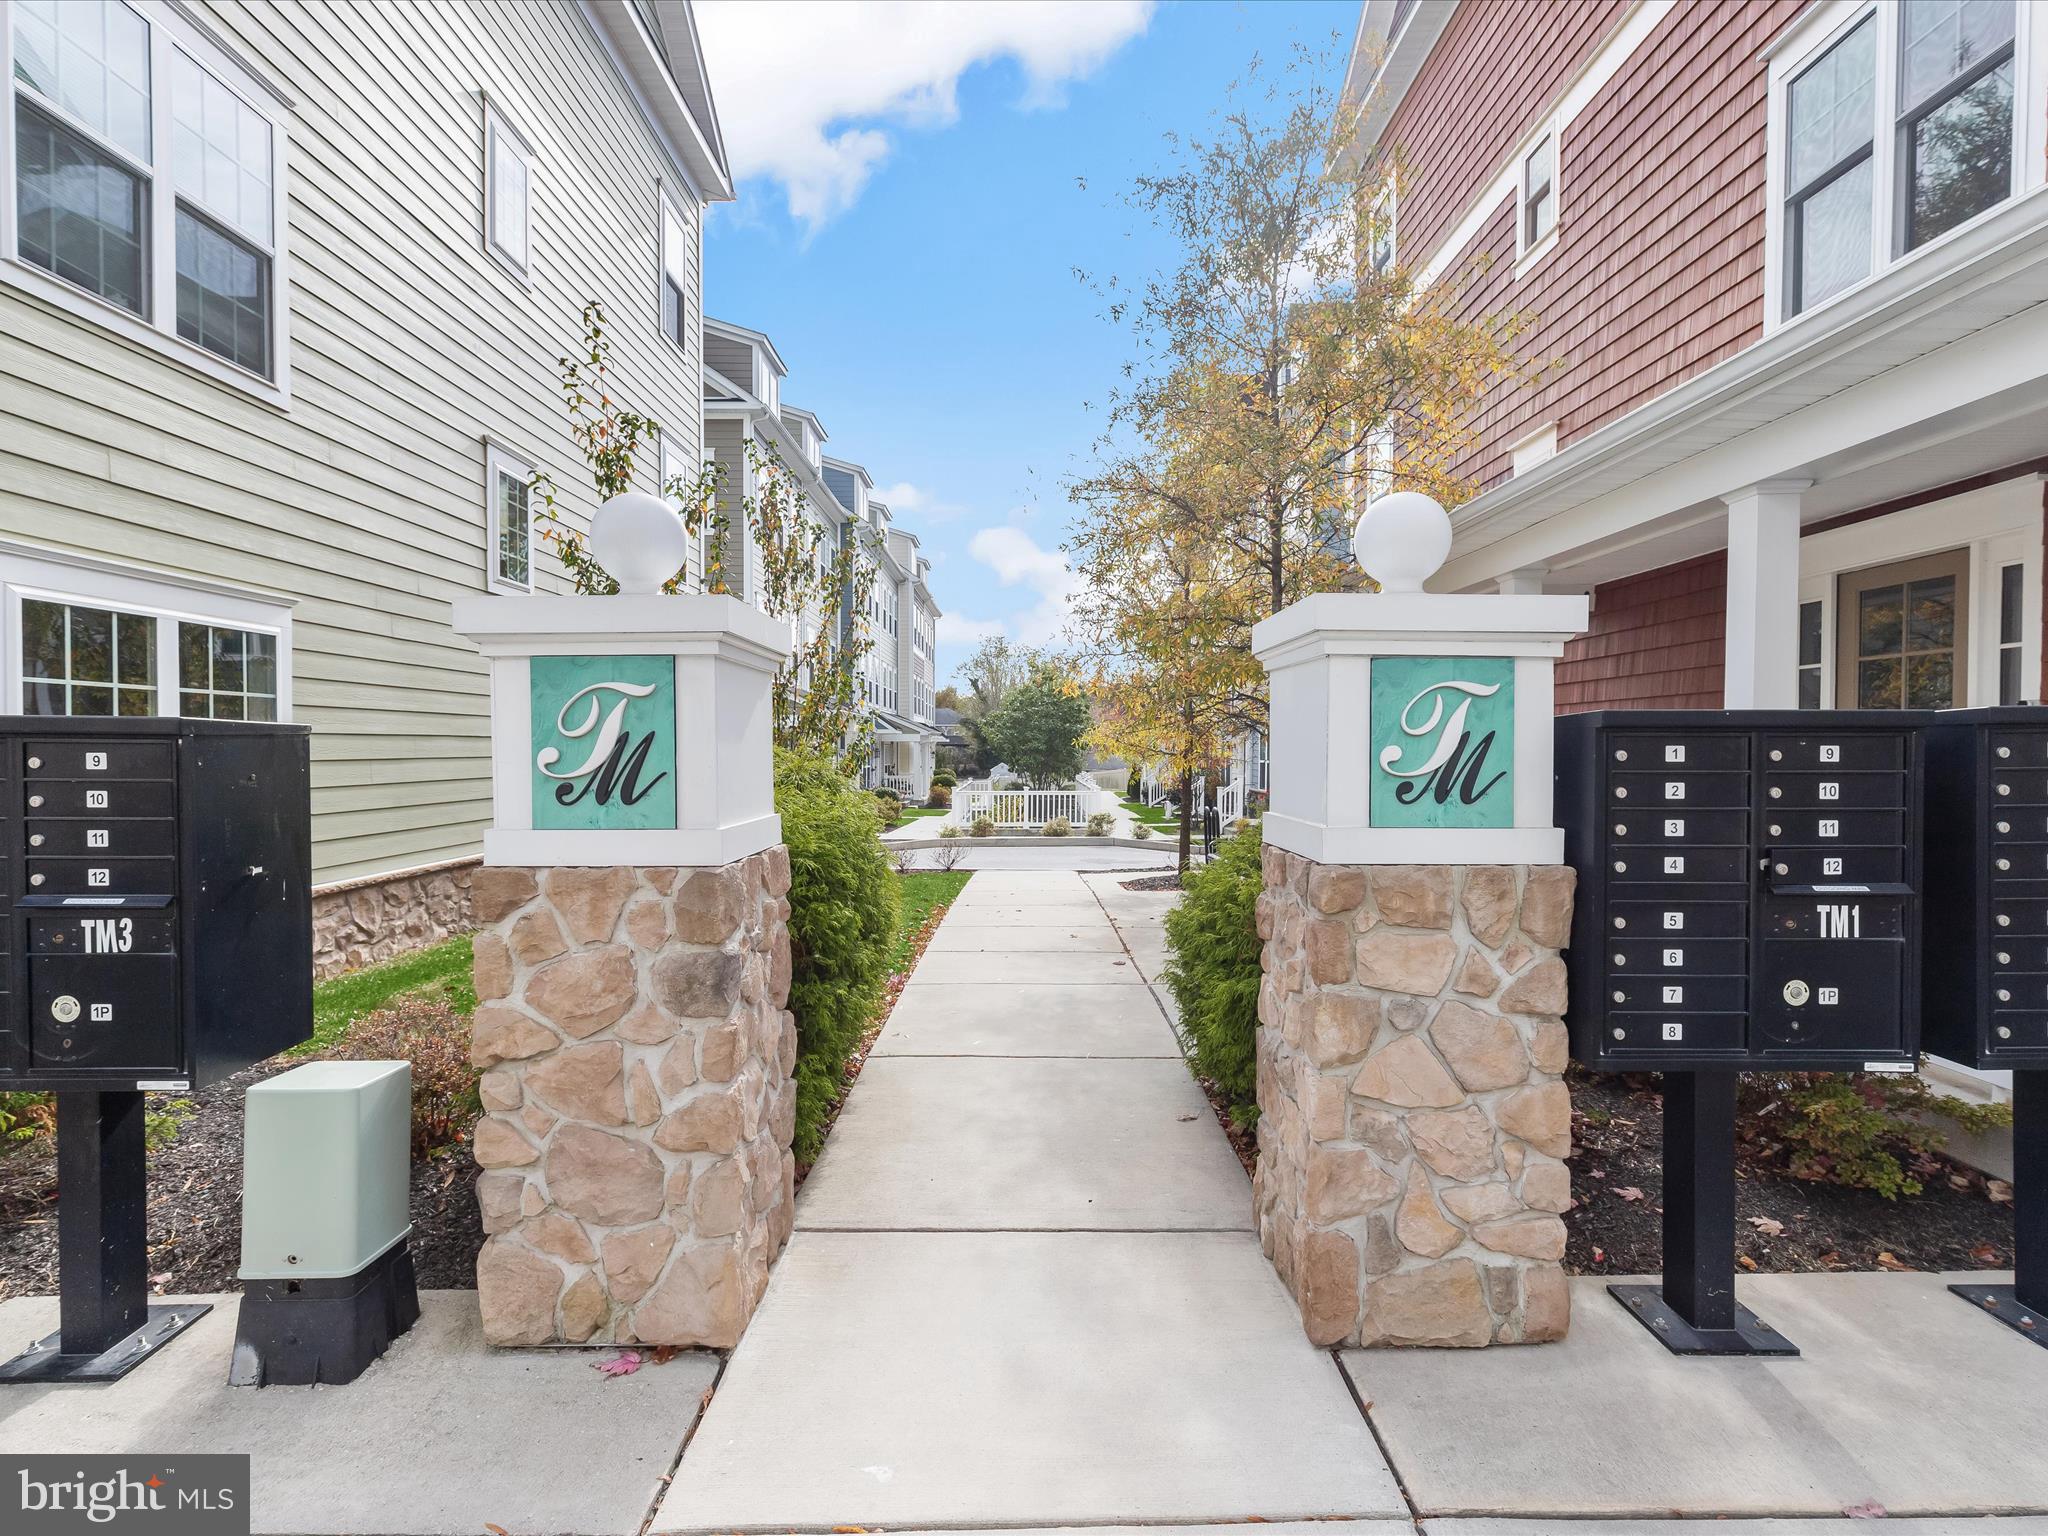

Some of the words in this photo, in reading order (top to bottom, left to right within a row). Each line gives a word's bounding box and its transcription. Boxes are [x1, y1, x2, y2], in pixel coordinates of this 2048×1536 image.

[1826, 747, 1834, 760] 9
[92, 755, 101, 767] 9
[1671, 785, 1679, 797] 2
[1822, 785, 1837, 797] 10
[89, 793, 104, 805] 10
[1670, 822, 1678, 834] 3
[1822, 822, 1835, 834] 11
[91, 832, 104, 845] 11
[1669, 859, 1678, 871] 4
[1825, 860, 1840, 872] 12
[91, 871, 106, 884] 12
[1669, 915, 1677, 927] 5
[1817, 905, 1859, 938] TM1
[81, 918, 132, 953] TM3
[1669, 951, 1677, 964] 6
[1668, 989, 1677, 1001] 7
[1820, 990, 1837, 1002] 1P
[93, 1006, 110, 1019] 1P
[1668, 1026, 1677, 1038] 8
